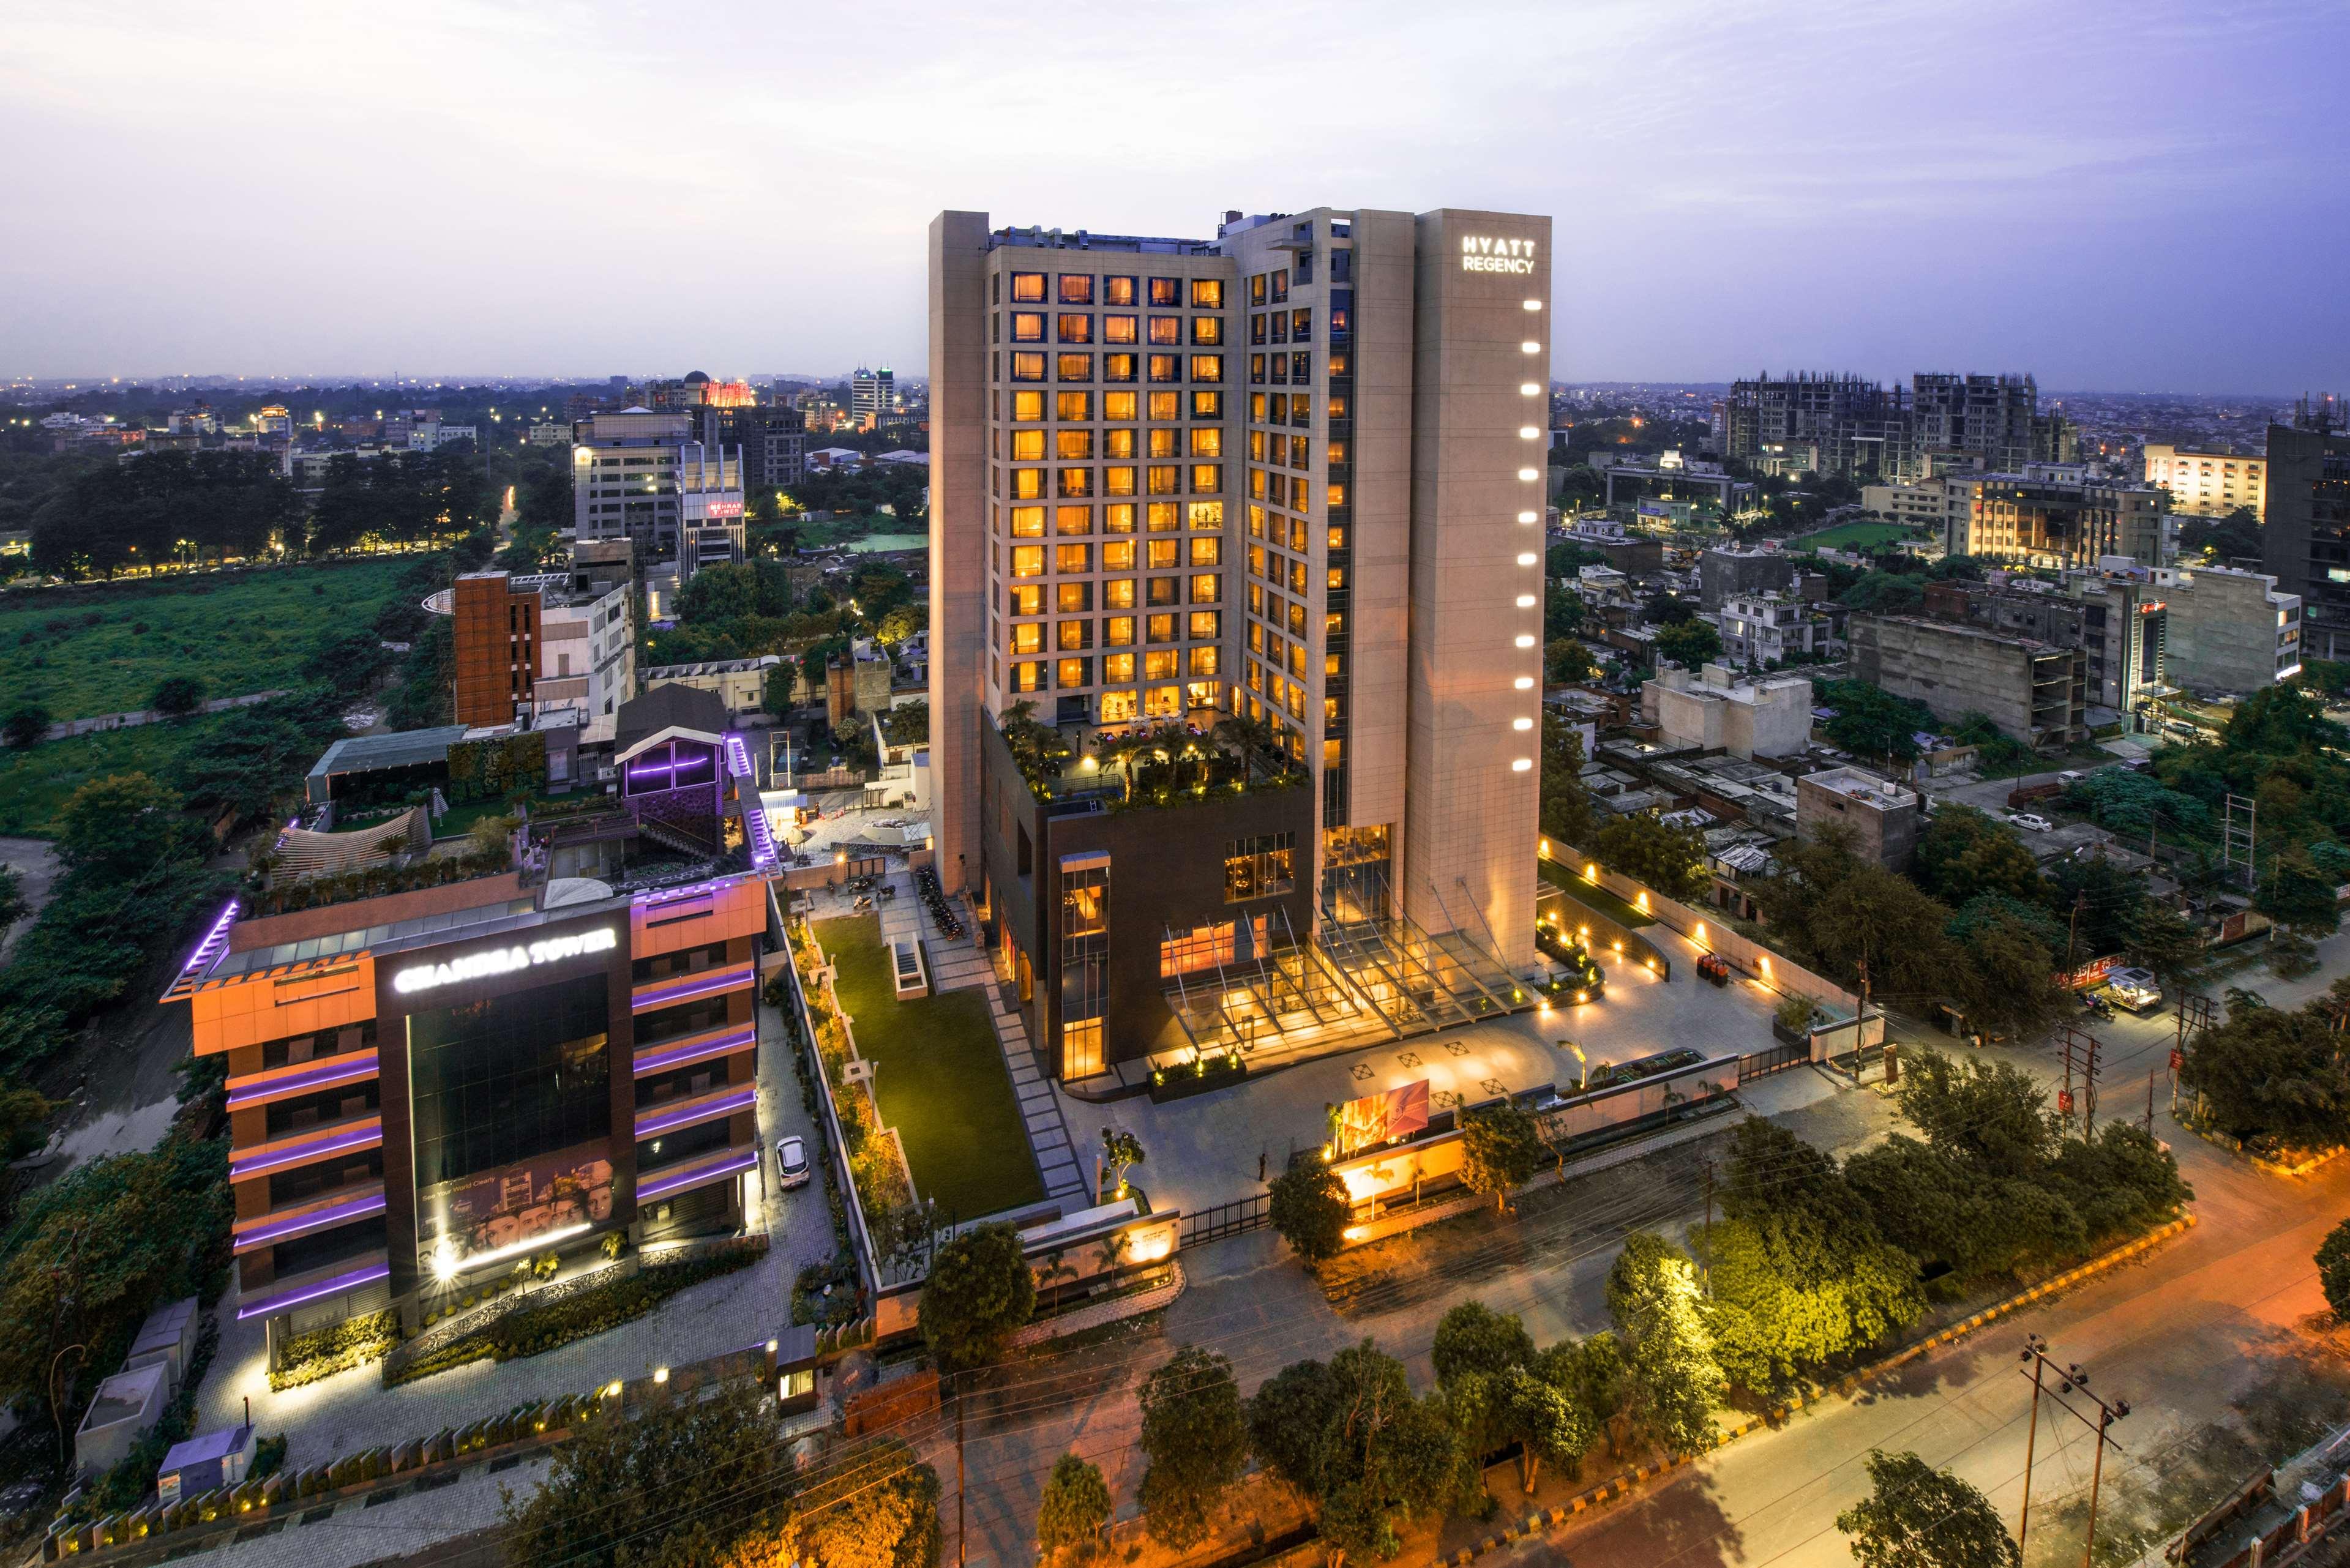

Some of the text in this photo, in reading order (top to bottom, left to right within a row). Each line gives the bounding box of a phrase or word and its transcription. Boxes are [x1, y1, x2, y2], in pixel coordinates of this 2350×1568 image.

[1463, 236, 1535, 257] HYATT
[1463, 256, 1535, 274] REGENCY
[394, 928, 616, 993] CHANDRA TOWER
[453, 1183, 472, 1193] World
[473, 1176, 495, 1187] Clearly
